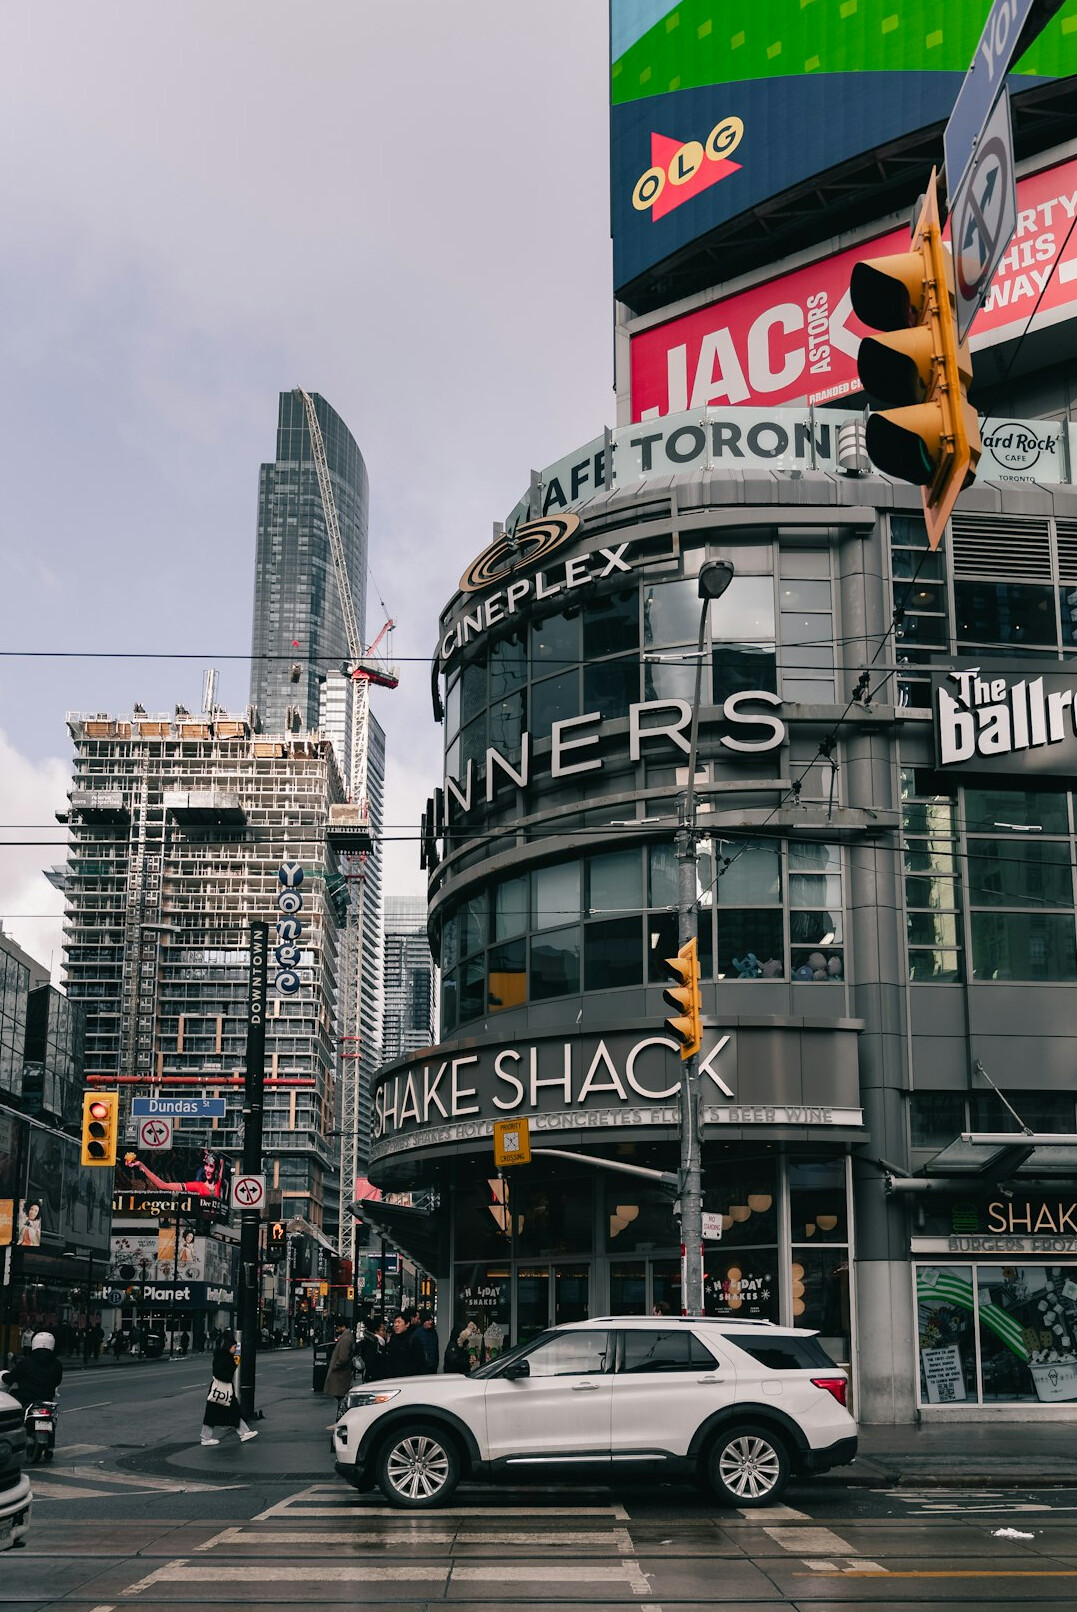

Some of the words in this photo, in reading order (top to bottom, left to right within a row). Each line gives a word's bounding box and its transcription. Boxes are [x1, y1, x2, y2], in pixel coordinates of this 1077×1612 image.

[633, 118, 743, 209] OLG
[982, 264, 1054, 314] WAY
[806, 291, 832, 375] ASTORS
[1016, 433, 1056, 454] Rock
[1005, 454, 1027, 462] CAFE
[998, 474, 1036, 483] TORONTO
[440, 540, 633, 661] CINEPLEX
[949, 666, 1007, 708] The
[938, 676, 1077, 765] ballr
[275, 862, 302, 995] Yonge
[251, 930, 264, 1024] DOWNTOWN
[374, 1054, 481, 1138] SHAKE
[492, 1035, 735, 1110] SHACK
[149, 1100, 198, 1113] Dundas
[728, 1107, 776, 1122] BEER
[785, 1107, 833, 1123] WINE
[129, 1196, 192, 1216] Legend
[948, 1238, 1025, 1252] BURGERS
[143, 1286, 191, 1301] Planet
[468, 1298, 497, 1306] SHAKES
[718, 1292, 758, 1301] SHAKES
